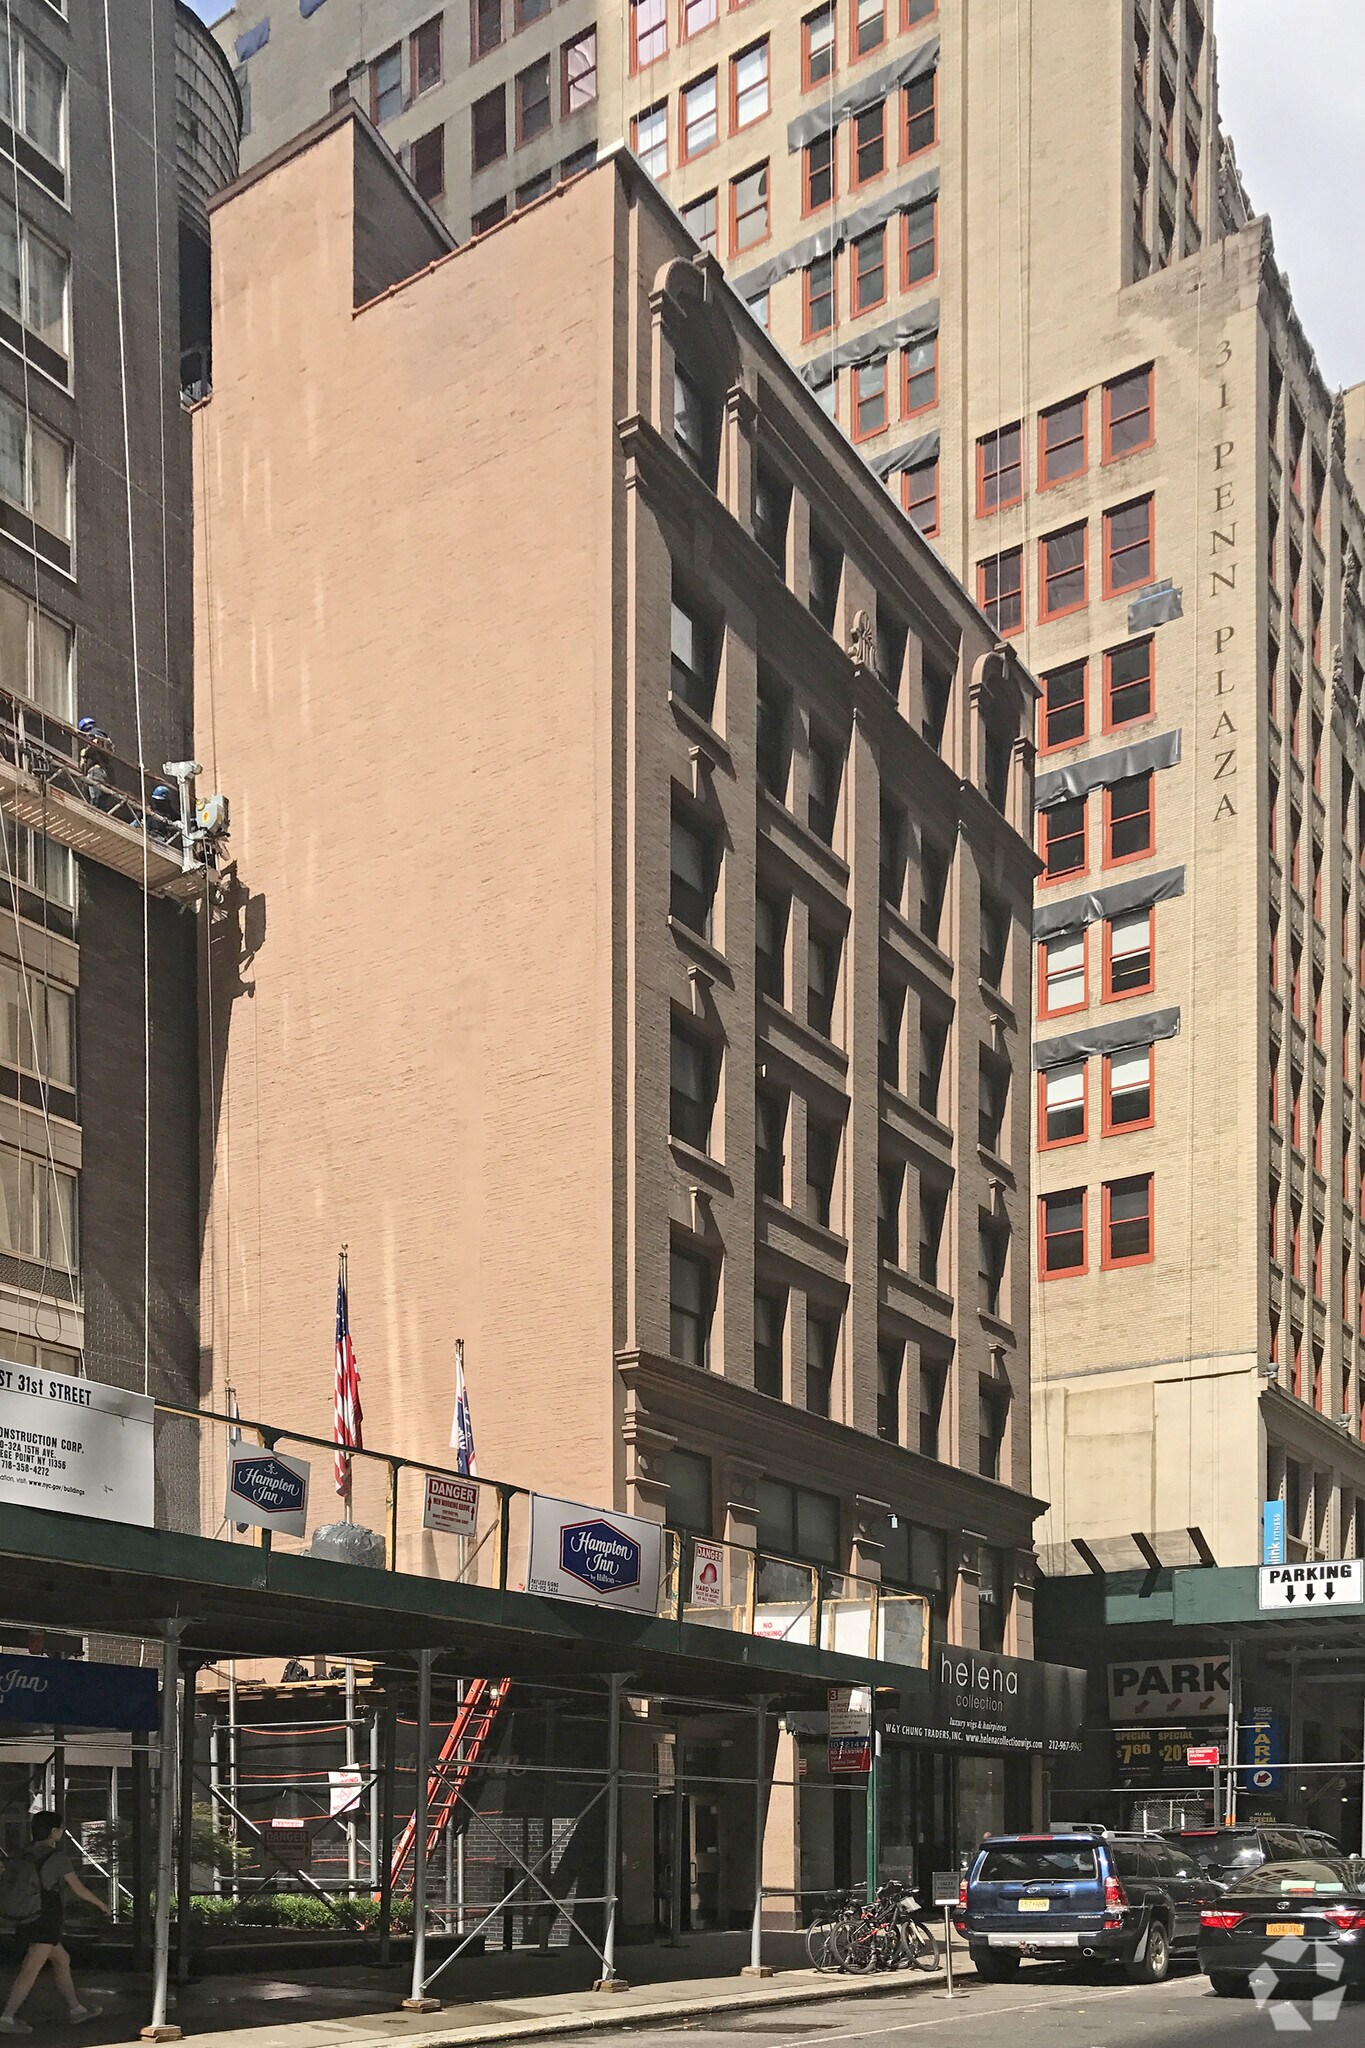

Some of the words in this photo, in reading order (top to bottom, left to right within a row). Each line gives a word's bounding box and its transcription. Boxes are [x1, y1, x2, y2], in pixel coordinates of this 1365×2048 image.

[1215, 339, 1232, 410] 31
[1209, 441, 1239, 597] PENN
[1211, 626, 1239, 822] PLAZA
[18, 1374, 43, 1395] 31st
[49, 1382, 91, 1406] STREET
[24, 1445, 39, 1455] 15TH
[42, 1449, 56, 1458] AVE.
[61, 1439, 85, 1454] CORP.
[1, 1459, 50, 1476] 718-358-4272
[15, 1453, 34, 1464] POINT
[37, 1456, 46, 1465] NY
[48, 1459, 67, 1470] 11356
[238, 1468, 300, 1496] Hampton
[253, 1486, 283, 1505] Inn
[431, 1481, 475, 1502] DANGER
[570, 1531, 633, 1561] Hampton
[697, 1547, 722, 1560] DANGER
[586, 1553, 619, 1575] Inn
[597, 1574, 615, 1584] Hilton
[1269, 1564, 1352, 1584] PARKING
[695, 1584, 709, 1593] HARD
[710, 1587, 720, 1595] HAT
[763, 1622, 773, 1630] NO
[0, 1669, 48, 1693] Inn
[941, 1652, 1018, 1694] helena
[1113, 1661, 1230, 1697] PARK
[829, 1690, 837, 1700] 3
[955, 1694, 1003, 1711] collection
[949, 1716, 966, 1729] luxury
[967, 1719, 977, 1730] wigs
[983, 1721, 1007, 1732] hairpieces
[885, 1723, 900, 1734] W&Y
[902, 1725, 923, 1737] CHUNG
[965, 1733, 1043, 1750] www.helenacollectionwigs.com
[1115, 1731, 1151, 1741] SPECIAL
[1158, 1731, 1194, 1740] SPECIAL
[267, 1832, 306, 1842] DANGER
